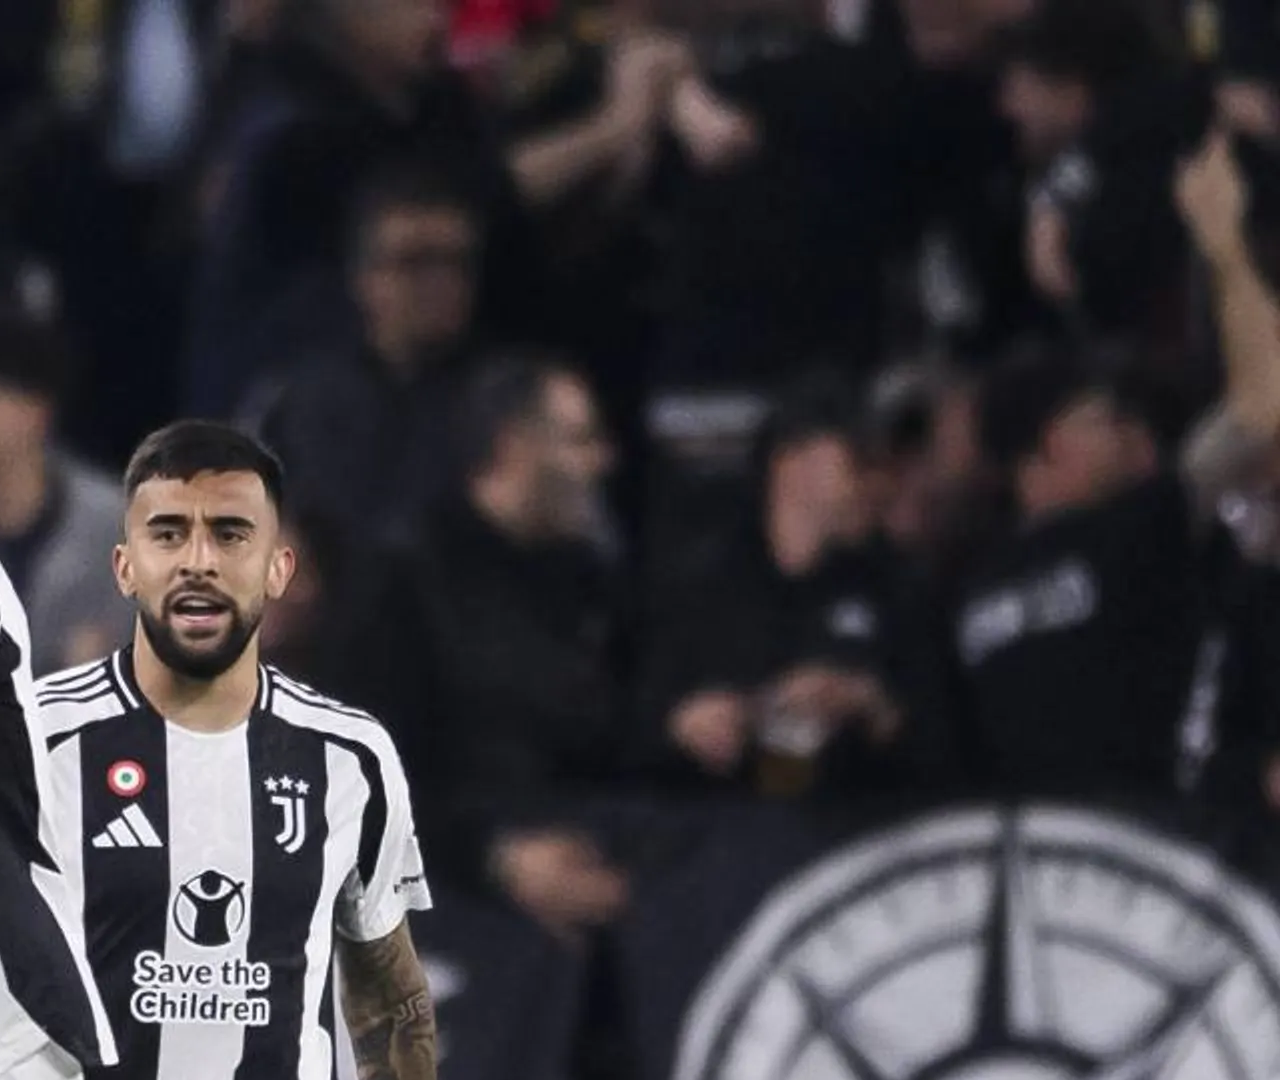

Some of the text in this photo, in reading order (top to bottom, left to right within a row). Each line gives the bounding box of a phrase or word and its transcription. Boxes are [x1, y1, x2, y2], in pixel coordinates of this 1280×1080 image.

[138, 954, 267, 986] Save the
[134, 991, 267, 1022] Children
